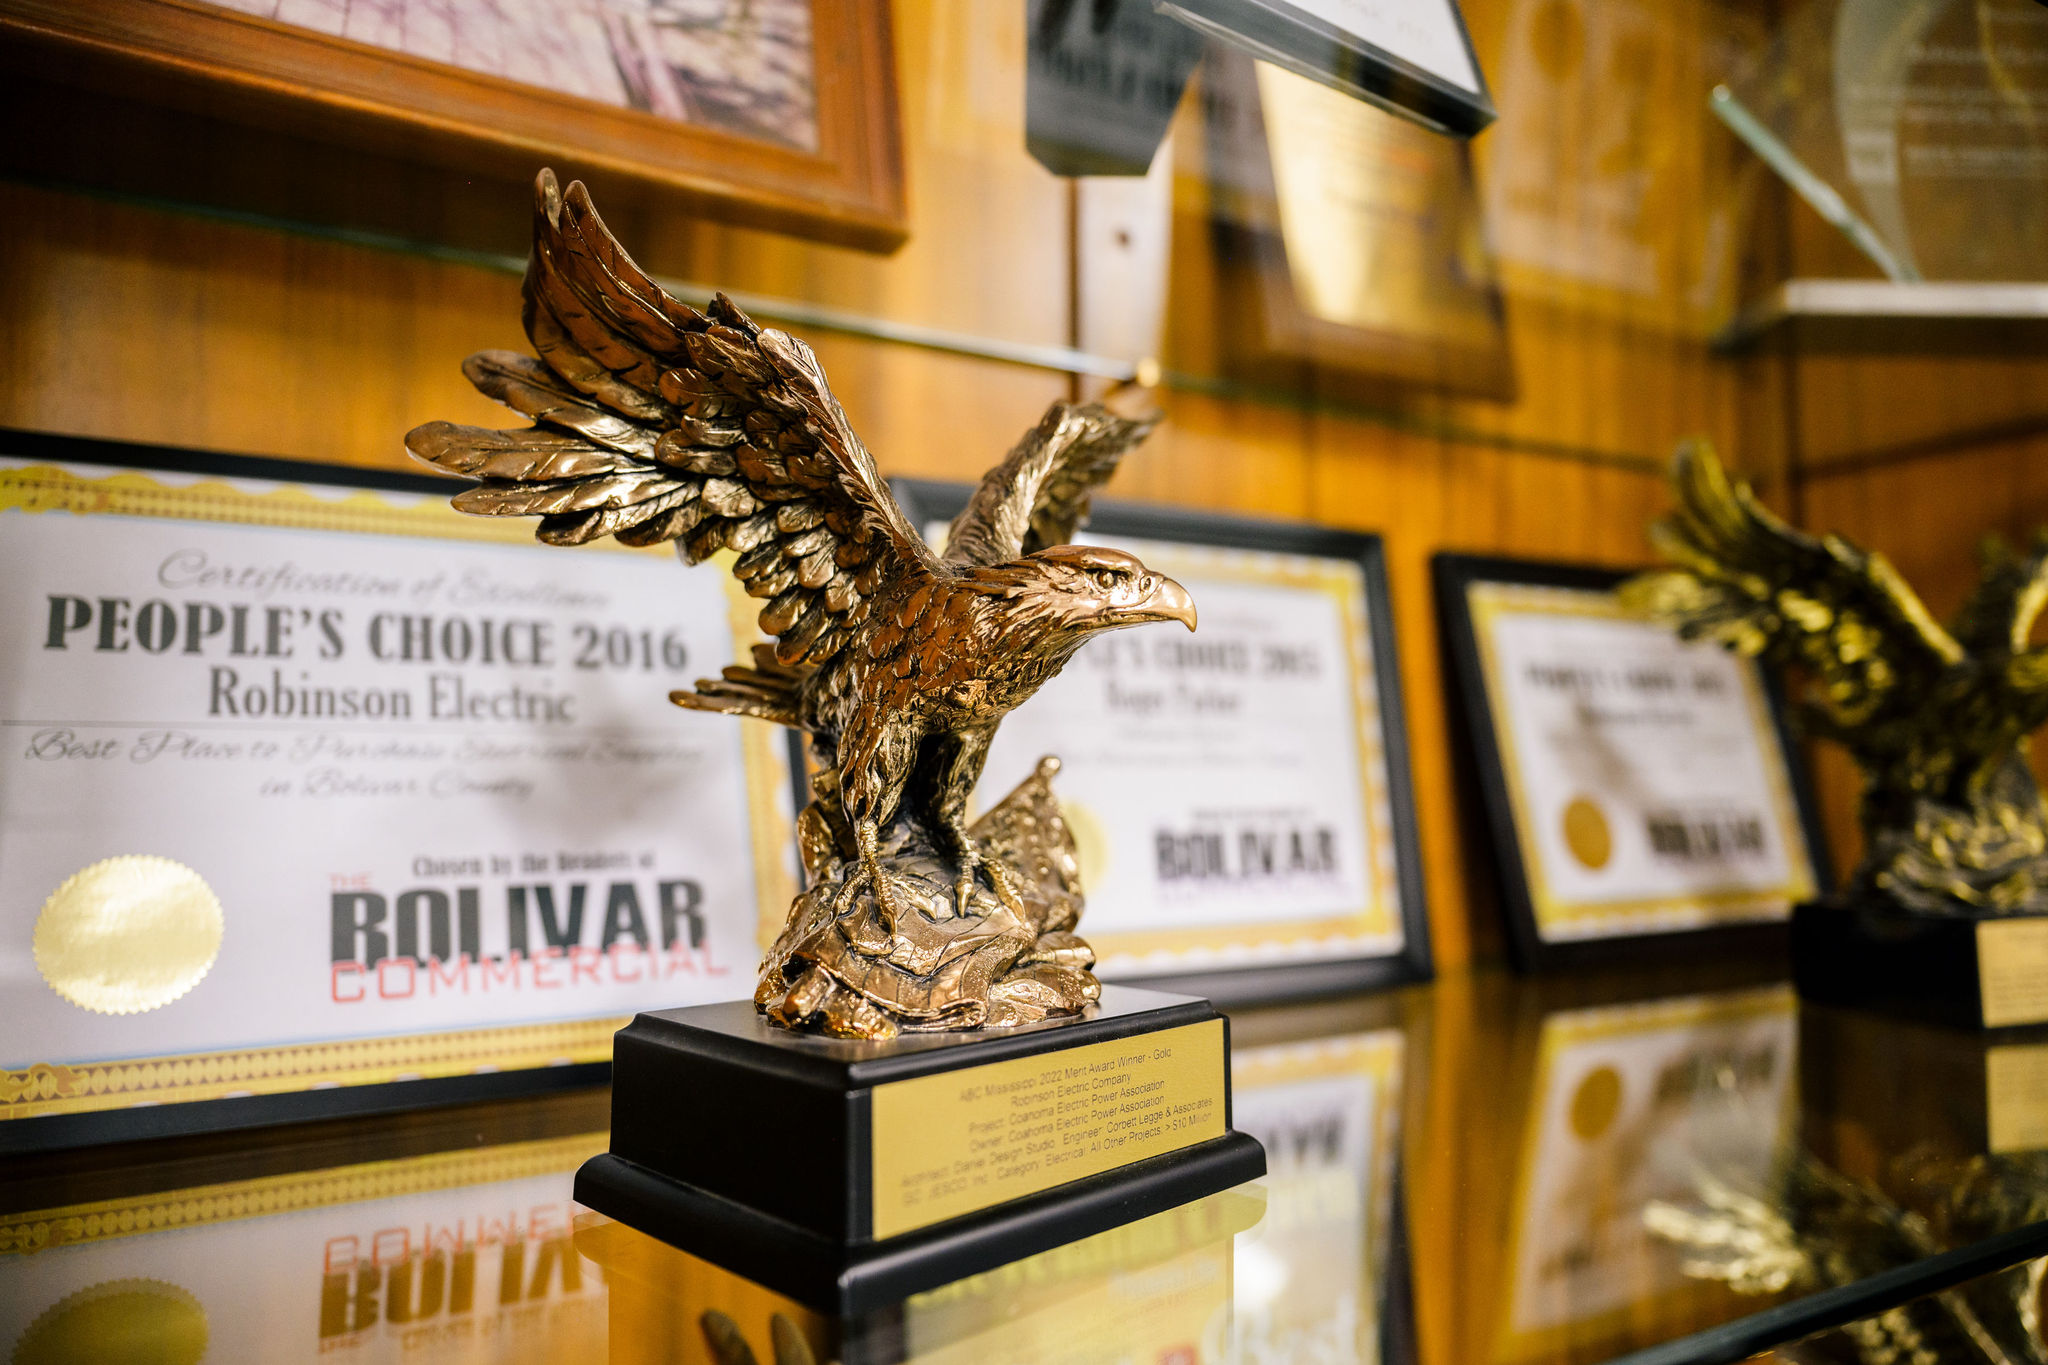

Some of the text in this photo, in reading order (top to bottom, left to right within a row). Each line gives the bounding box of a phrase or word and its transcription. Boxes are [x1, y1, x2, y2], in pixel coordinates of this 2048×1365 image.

[157, 548, 402, 599] Certification
[43, 594, 689, 672] PEOPLE'S CHOICE 2016
[207, 665, 577, 723] Robinson Electric
[24, 727, 118, 762] Best
[130, 730, 241, 764] Place
[248, 738, 280, 760] to
[260, 777, 291, 796] in
[327, 871, 374, 891] THE
[411, 852, 483, 878] Chosen
[489, 852, 512, 881] by
[519, 850, 550, 873] the
[330, 878, 708, 971] BOLIVAR
[331, 940, 731, 1004] COMMERCIAL
[985, 1078, 1037, 1097] Mississippi
[1039, 1069, 1063, 1086] 2022
[1064, 1066, 1087, 1080] Merit
[1088, 1060, 1115, 1075] Award
[1117, 1053, 1146, 1068] Winner
[1153, 1047, 1172, 1061] Gold
[1011, 1071, 1132, 1108] Robinson Electric Company
[1056, 1114, 1089, 1131] Electric
[1091, 1106, 1119, 1121] Power
[1119, 1095, 1165, 1114] Association
[1057, 1097, 1089, 1114] Electric
[1091, 1090, 1119, 1107] Power
[1119, 1079, 1165, 1098] Association
[1106, 1118, 1137, 1134] Corbett
[1138, 1110, 1164, 1126] Legge
[1172, 1097, 1214, 1115] Associates
[1090, 1141, 1101, 1153] All
[1103, 1134, 1128, 1151] Other
[1172, 1116, 1187, 1132] $10
